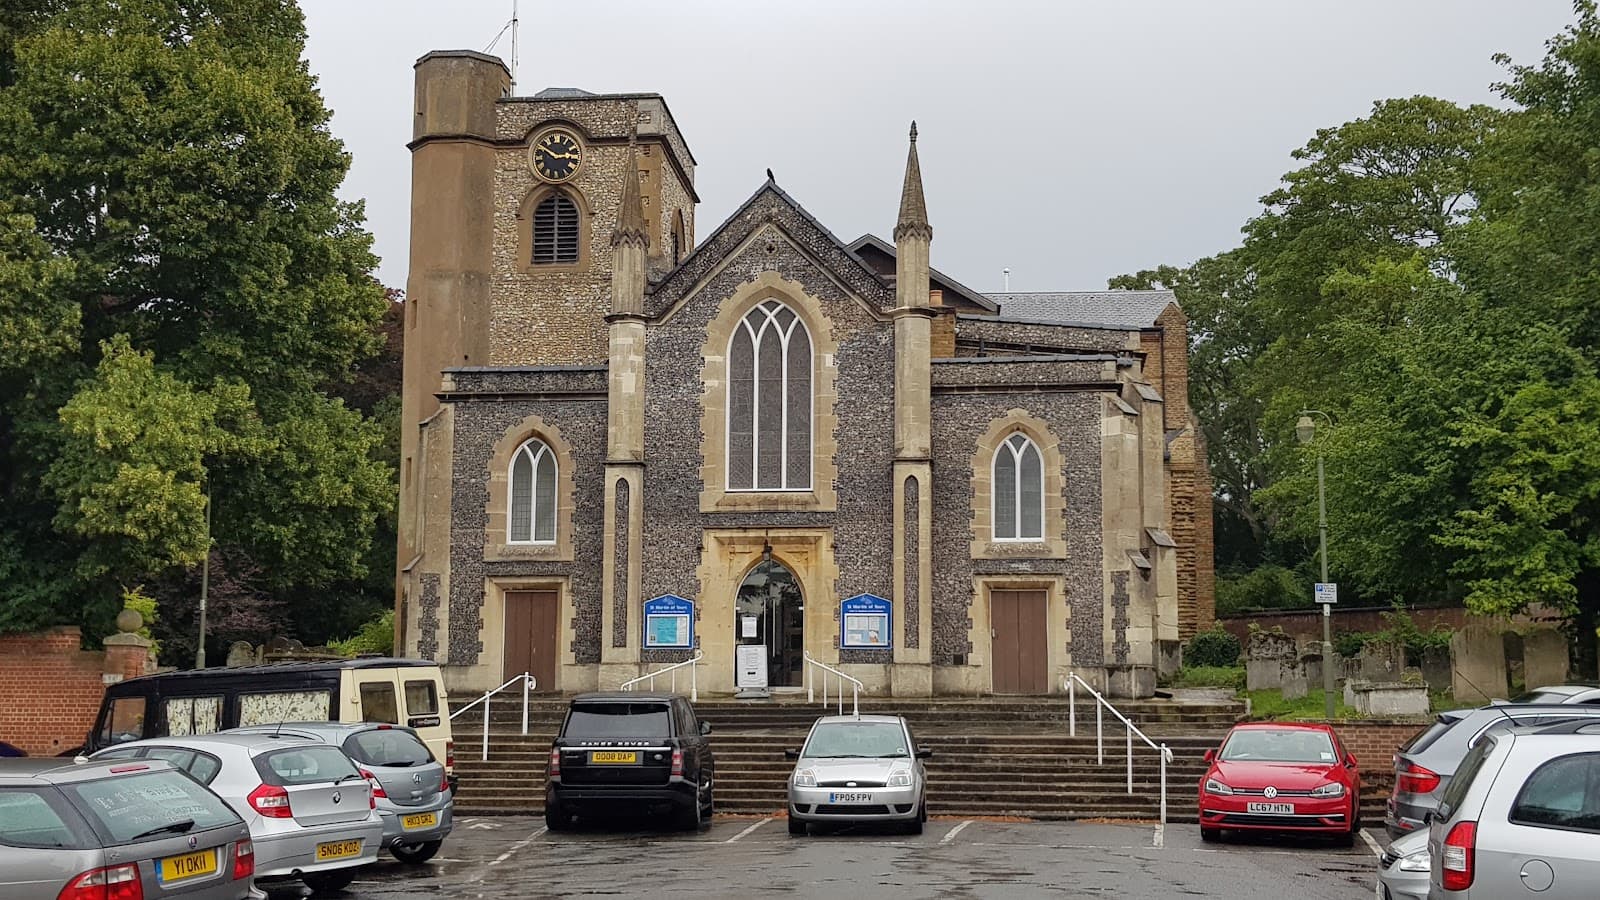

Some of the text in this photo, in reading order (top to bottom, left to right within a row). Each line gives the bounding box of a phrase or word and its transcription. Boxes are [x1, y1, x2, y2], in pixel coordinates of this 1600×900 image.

[617, 752, 633, 761] DAP
[835, 793, 872, 801] FP05 FPV
[1250, 803, 1290, 812] LC67 HTN
[321, 843, 343, 857] SN06
